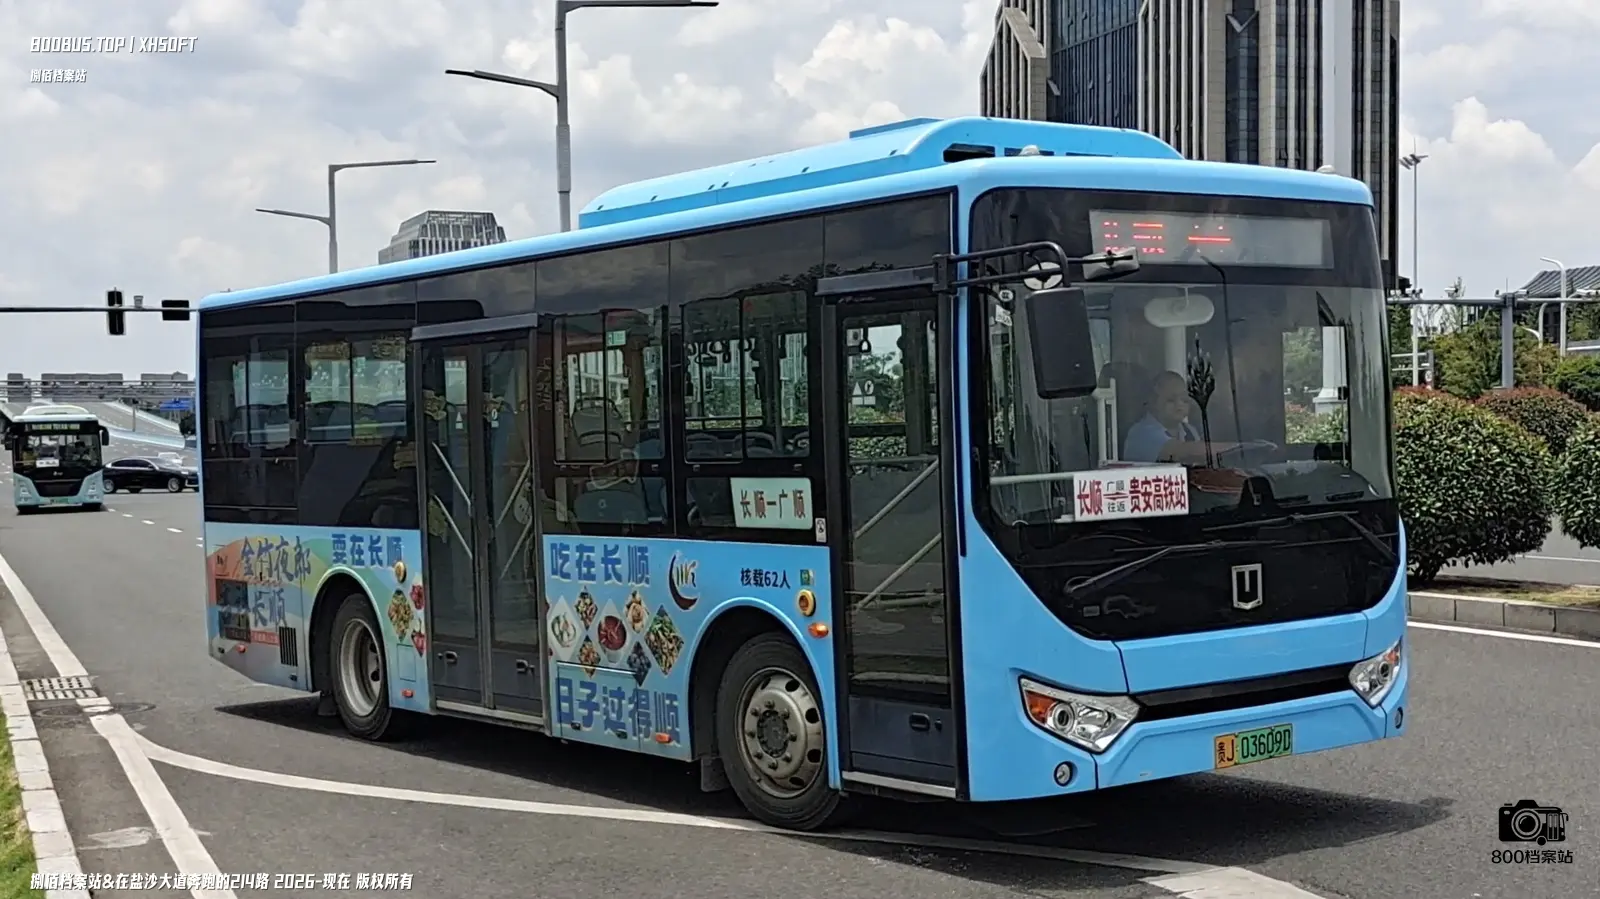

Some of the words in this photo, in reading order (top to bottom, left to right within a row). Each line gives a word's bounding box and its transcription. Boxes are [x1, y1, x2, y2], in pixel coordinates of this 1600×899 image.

[1077, 479, 1103, 516] 长顺
[1129, 474, 1187, 513] 贵安高铁站
[550, 542, 650, 586] 吃在长顺
[740, 567, 791, 589] 核载62人
[555, 676, 682, 745] 日子过得顺
